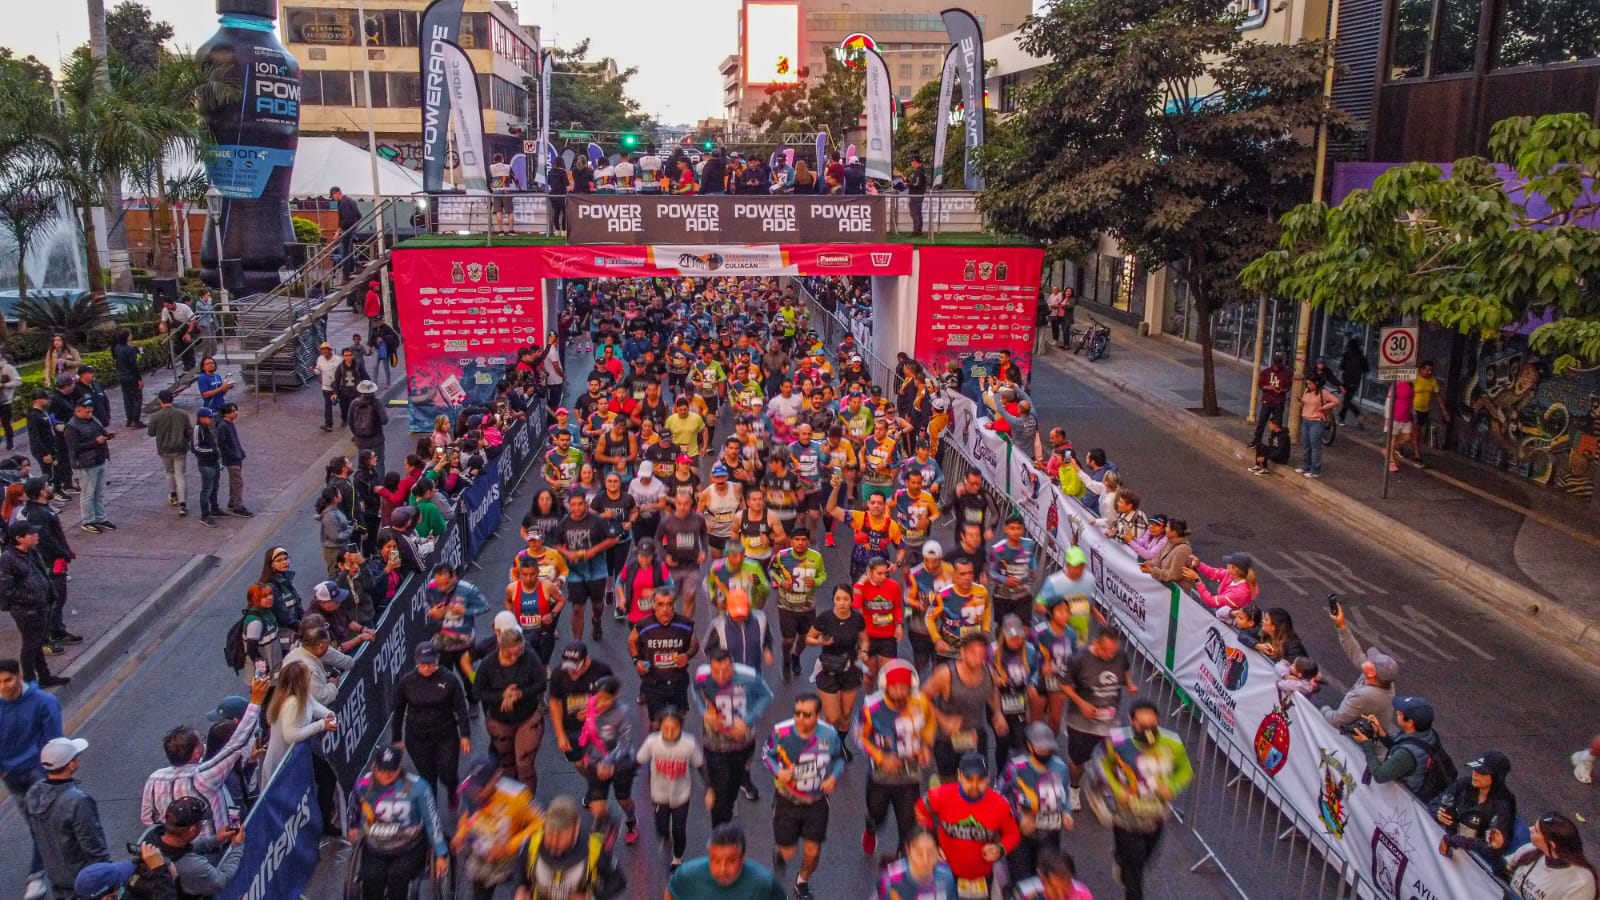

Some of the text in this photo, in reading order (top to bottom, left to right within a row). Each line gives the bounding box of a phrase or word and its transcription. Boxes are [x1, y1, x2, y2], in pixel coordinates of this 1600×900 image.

[424, 24, 449, 161] POWERADE
[256, 97, 297, 116] ADE
[578, 204, 642, 218] POWER
[657, 204, 719, 218] POWER
[734, 204, 796, 218] POWER
[811, 205, 872, 218] POWER
[607, 218, 643, 232] ADE
[685, 218, 720, 232] ADE
[762, 218, 797, 232] ADE
[838, 218, 872, 232] ADE
[1390, 336, 1407, 351] 30
[373, 613, 405, 685] POWER
[390, 636, 407, 685] ADE
[321, 678, 366, 755] POWER
[344, 704, 368, 763] ADE
